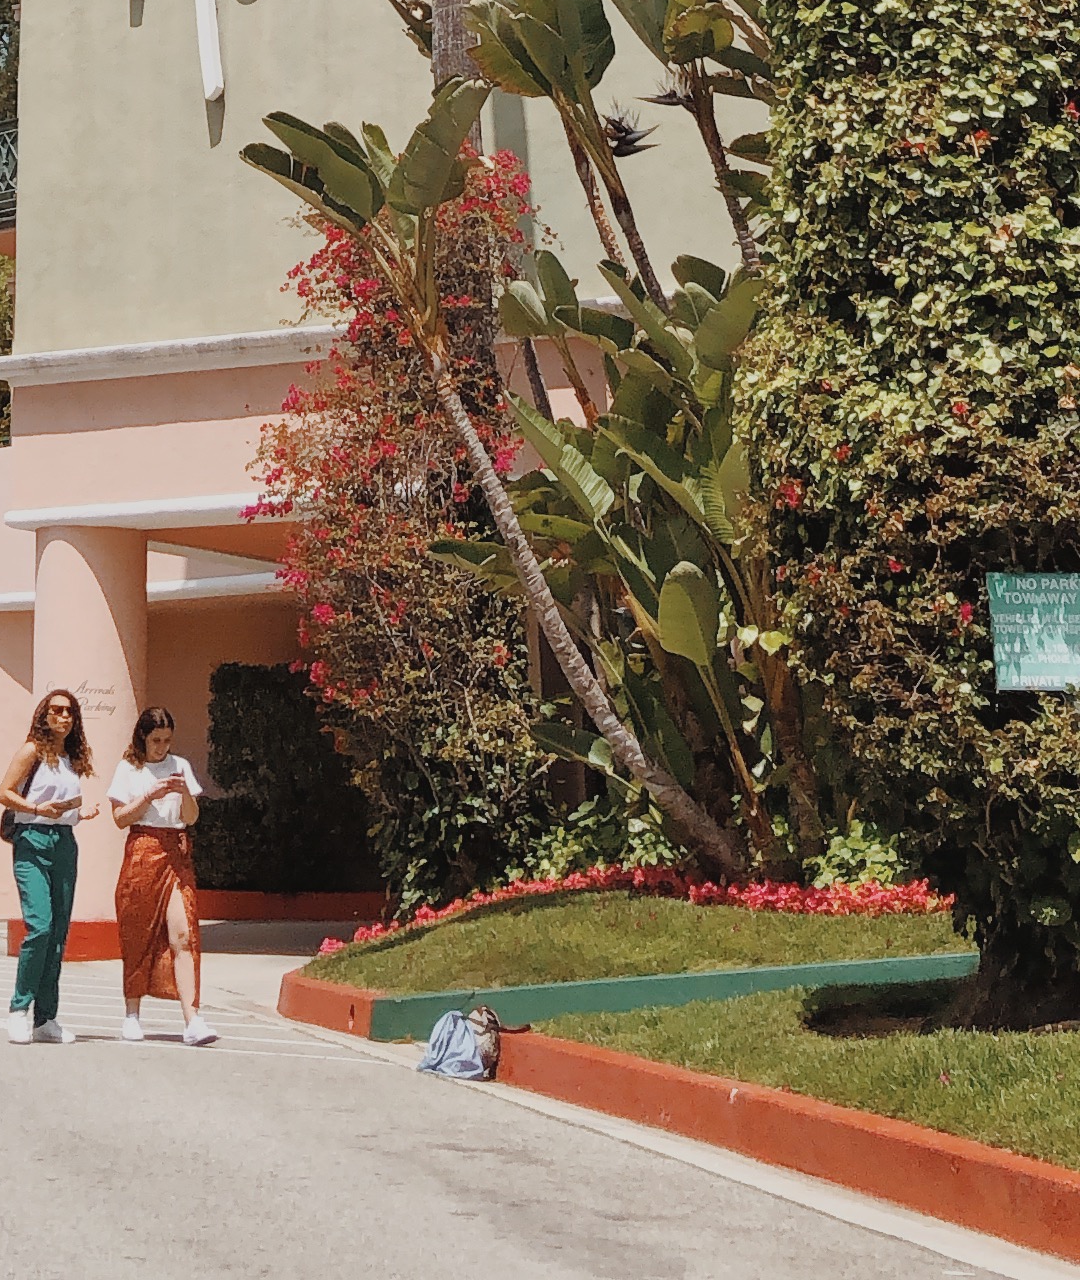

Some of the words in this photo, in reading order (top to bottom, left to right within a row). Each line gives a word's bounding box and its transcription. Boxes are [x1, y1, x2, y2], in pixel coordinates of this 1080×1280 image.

[1016, 578, 1037, 590] NO
[1041, 578, 1080, 590] PARK
[993, 613, 1038, 623] VEHILE
[1011, 675, 1061, 687] PRIVATE
[77, 696, 116, 716] Parking
